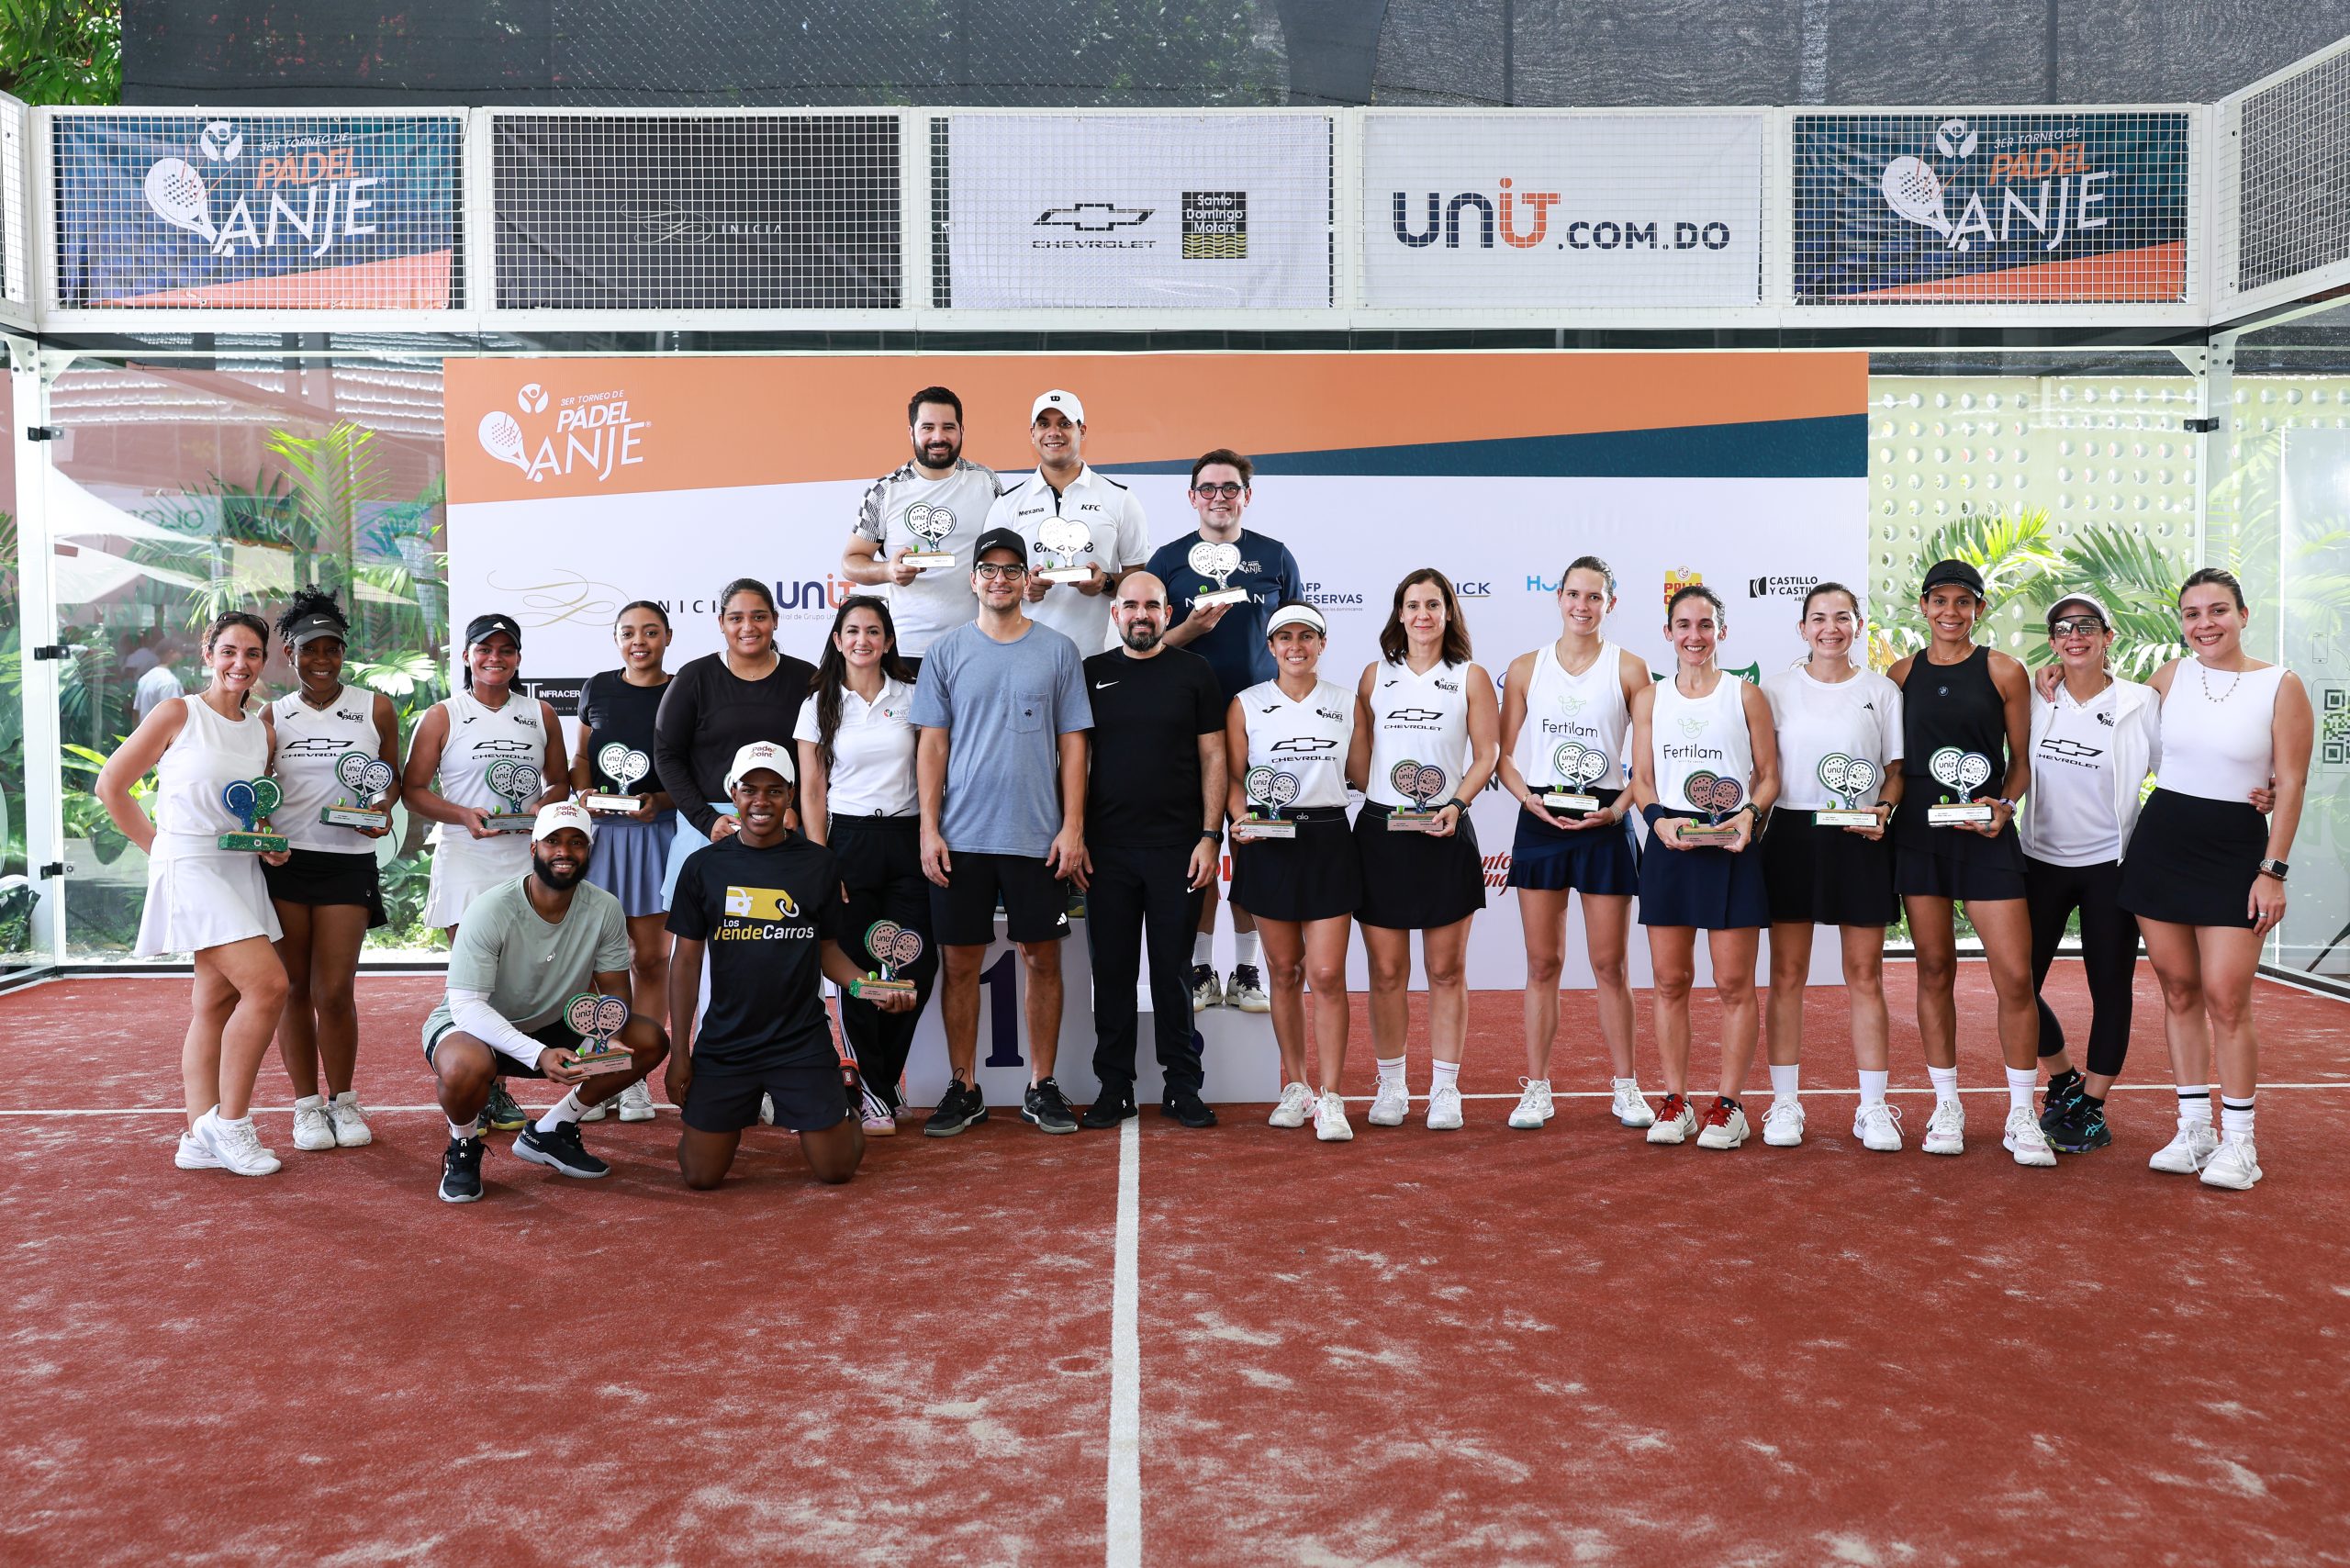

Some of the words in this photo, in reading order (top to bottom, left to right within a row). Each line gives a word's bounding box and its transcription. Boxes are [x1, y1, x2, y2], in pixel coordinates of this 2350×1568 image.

[285, 134, 330, 148] TORNEO
[2019, 130, 2063, 144] TORNEO
[2066, 128, 2081, 139] DE
[256, 147, 360, 190] PÁDEL
[1988, 143, 2091, 185] PÁDEL
[1196, 195, 1233, 207] Santo
[212, 178, 378, 258] ANJE
[1185, 208, 1244, 222] Domingo
[1947, 171, 2109, 252] ANJE
[1194, 221, 1237, 233] Motors
[1032, 240, 1157, 249] CHEVROLET
[561, 398, 576, 407] 3ER
[578, 392, 610, 404] TORNEO
[612, 389, 624, 398] DE
[556, 401, 632, 433] PÁDEL
[526, 421, 645, 482] ANJE
[1018, 507, 1045, 517] Mexana
[1080, 503, 1102, 511] KFC
[1770, 577, 1818, 585] CASTILLO
[1770, 587, 1776, 596] Y
[1304, 594, 1363, 604] ESERVAS
[803, 613, 825, 622] Grupo
[1542, 718, 1598, 738] Fertilam
[1663, 744, 1722, 760] Fertilam
[1296, 812, 1309, 820] alo
[979, 949, 1024, 1067] 1
